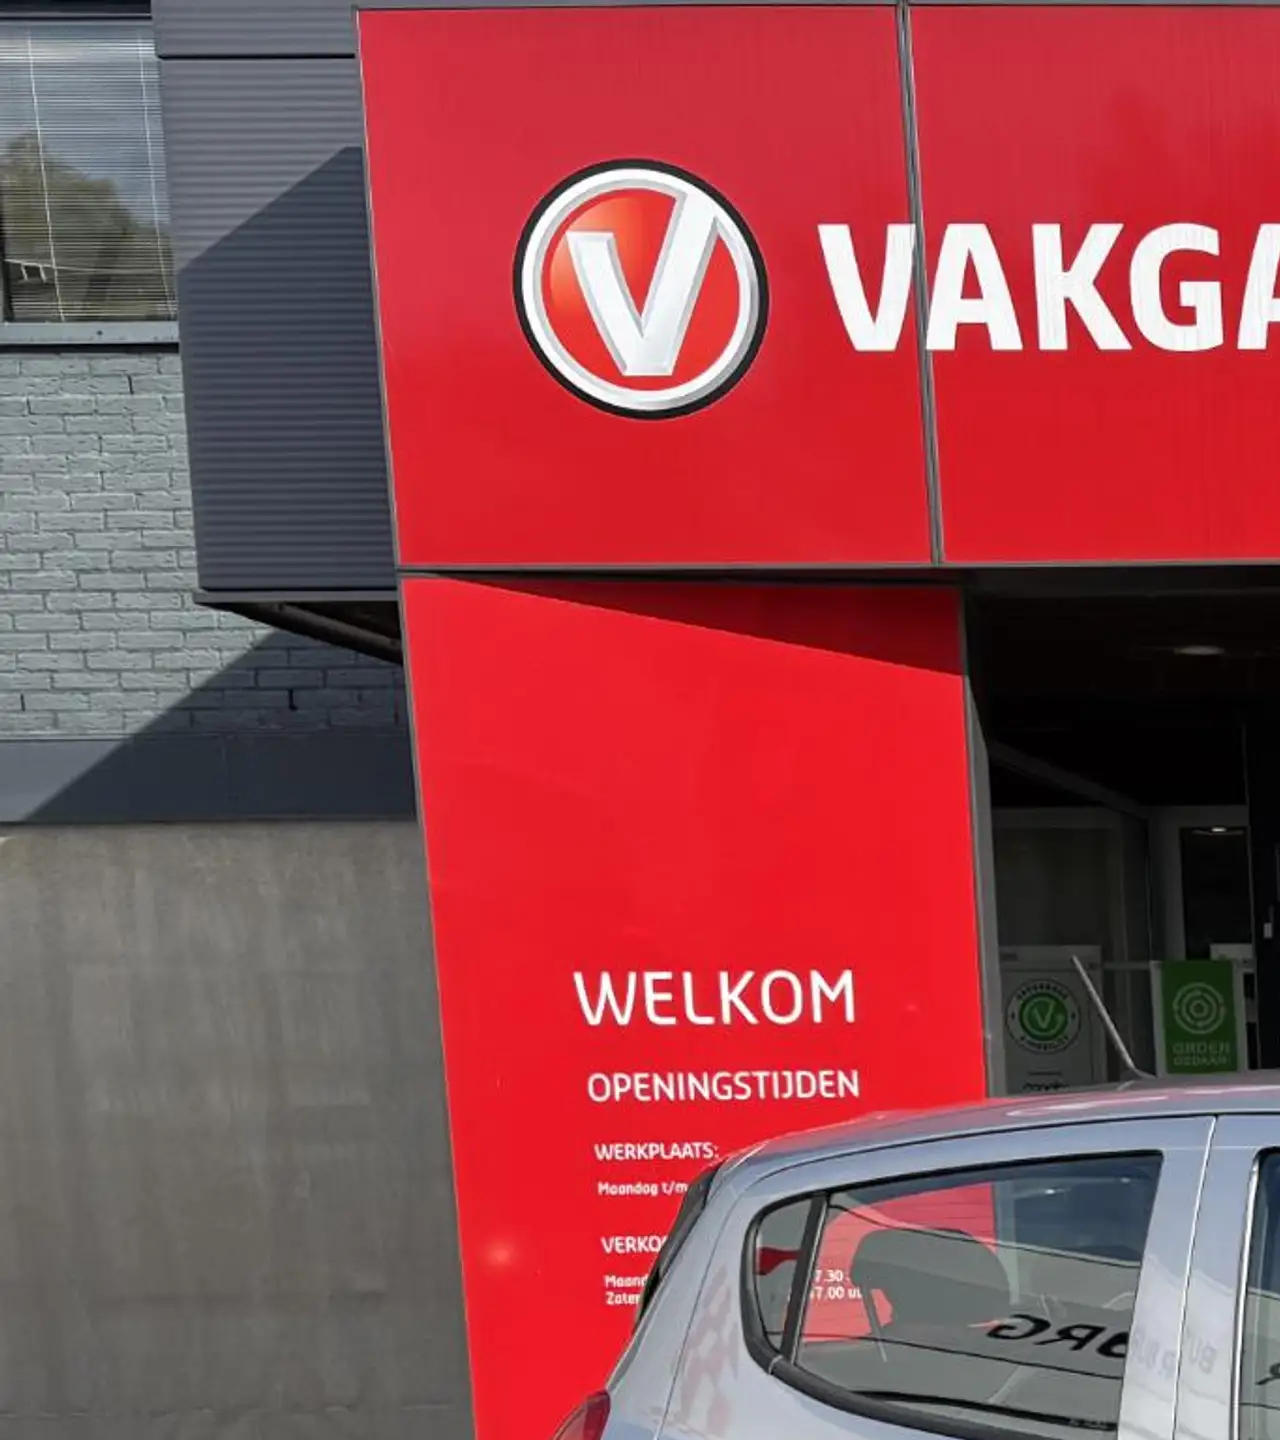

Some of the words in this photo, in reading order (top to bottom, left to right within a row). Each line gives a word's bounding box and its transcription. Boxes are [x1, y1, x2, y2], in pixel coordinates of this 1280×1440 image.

[573, 969, 856, 1026] WELKOM
[587, 1069, 860, 1103] OPENINGSTIJDEN
[593, 1141, 720, 1161] WERKPLAATS:
[597, 1180, 659, 1197] Maandag
